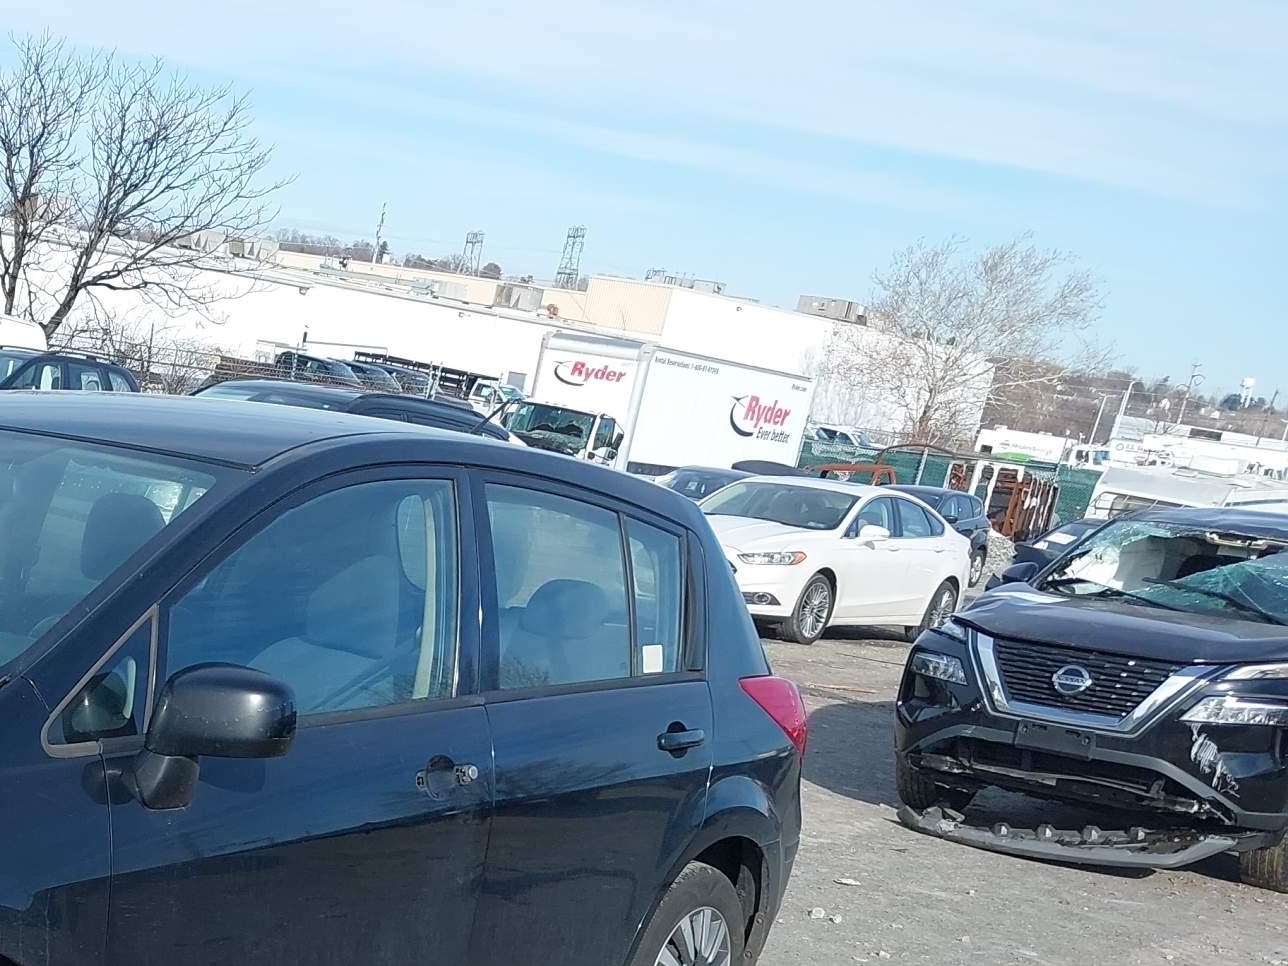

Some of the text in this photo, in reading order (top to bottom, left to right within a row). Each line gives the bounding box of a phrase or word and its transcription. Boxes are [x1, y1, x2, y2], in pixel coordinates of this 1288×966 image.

[570, 361, 627, 383] Ryder
[743, 395, 791, 428] Ryder
[756, 427, 771, 440] Ever
